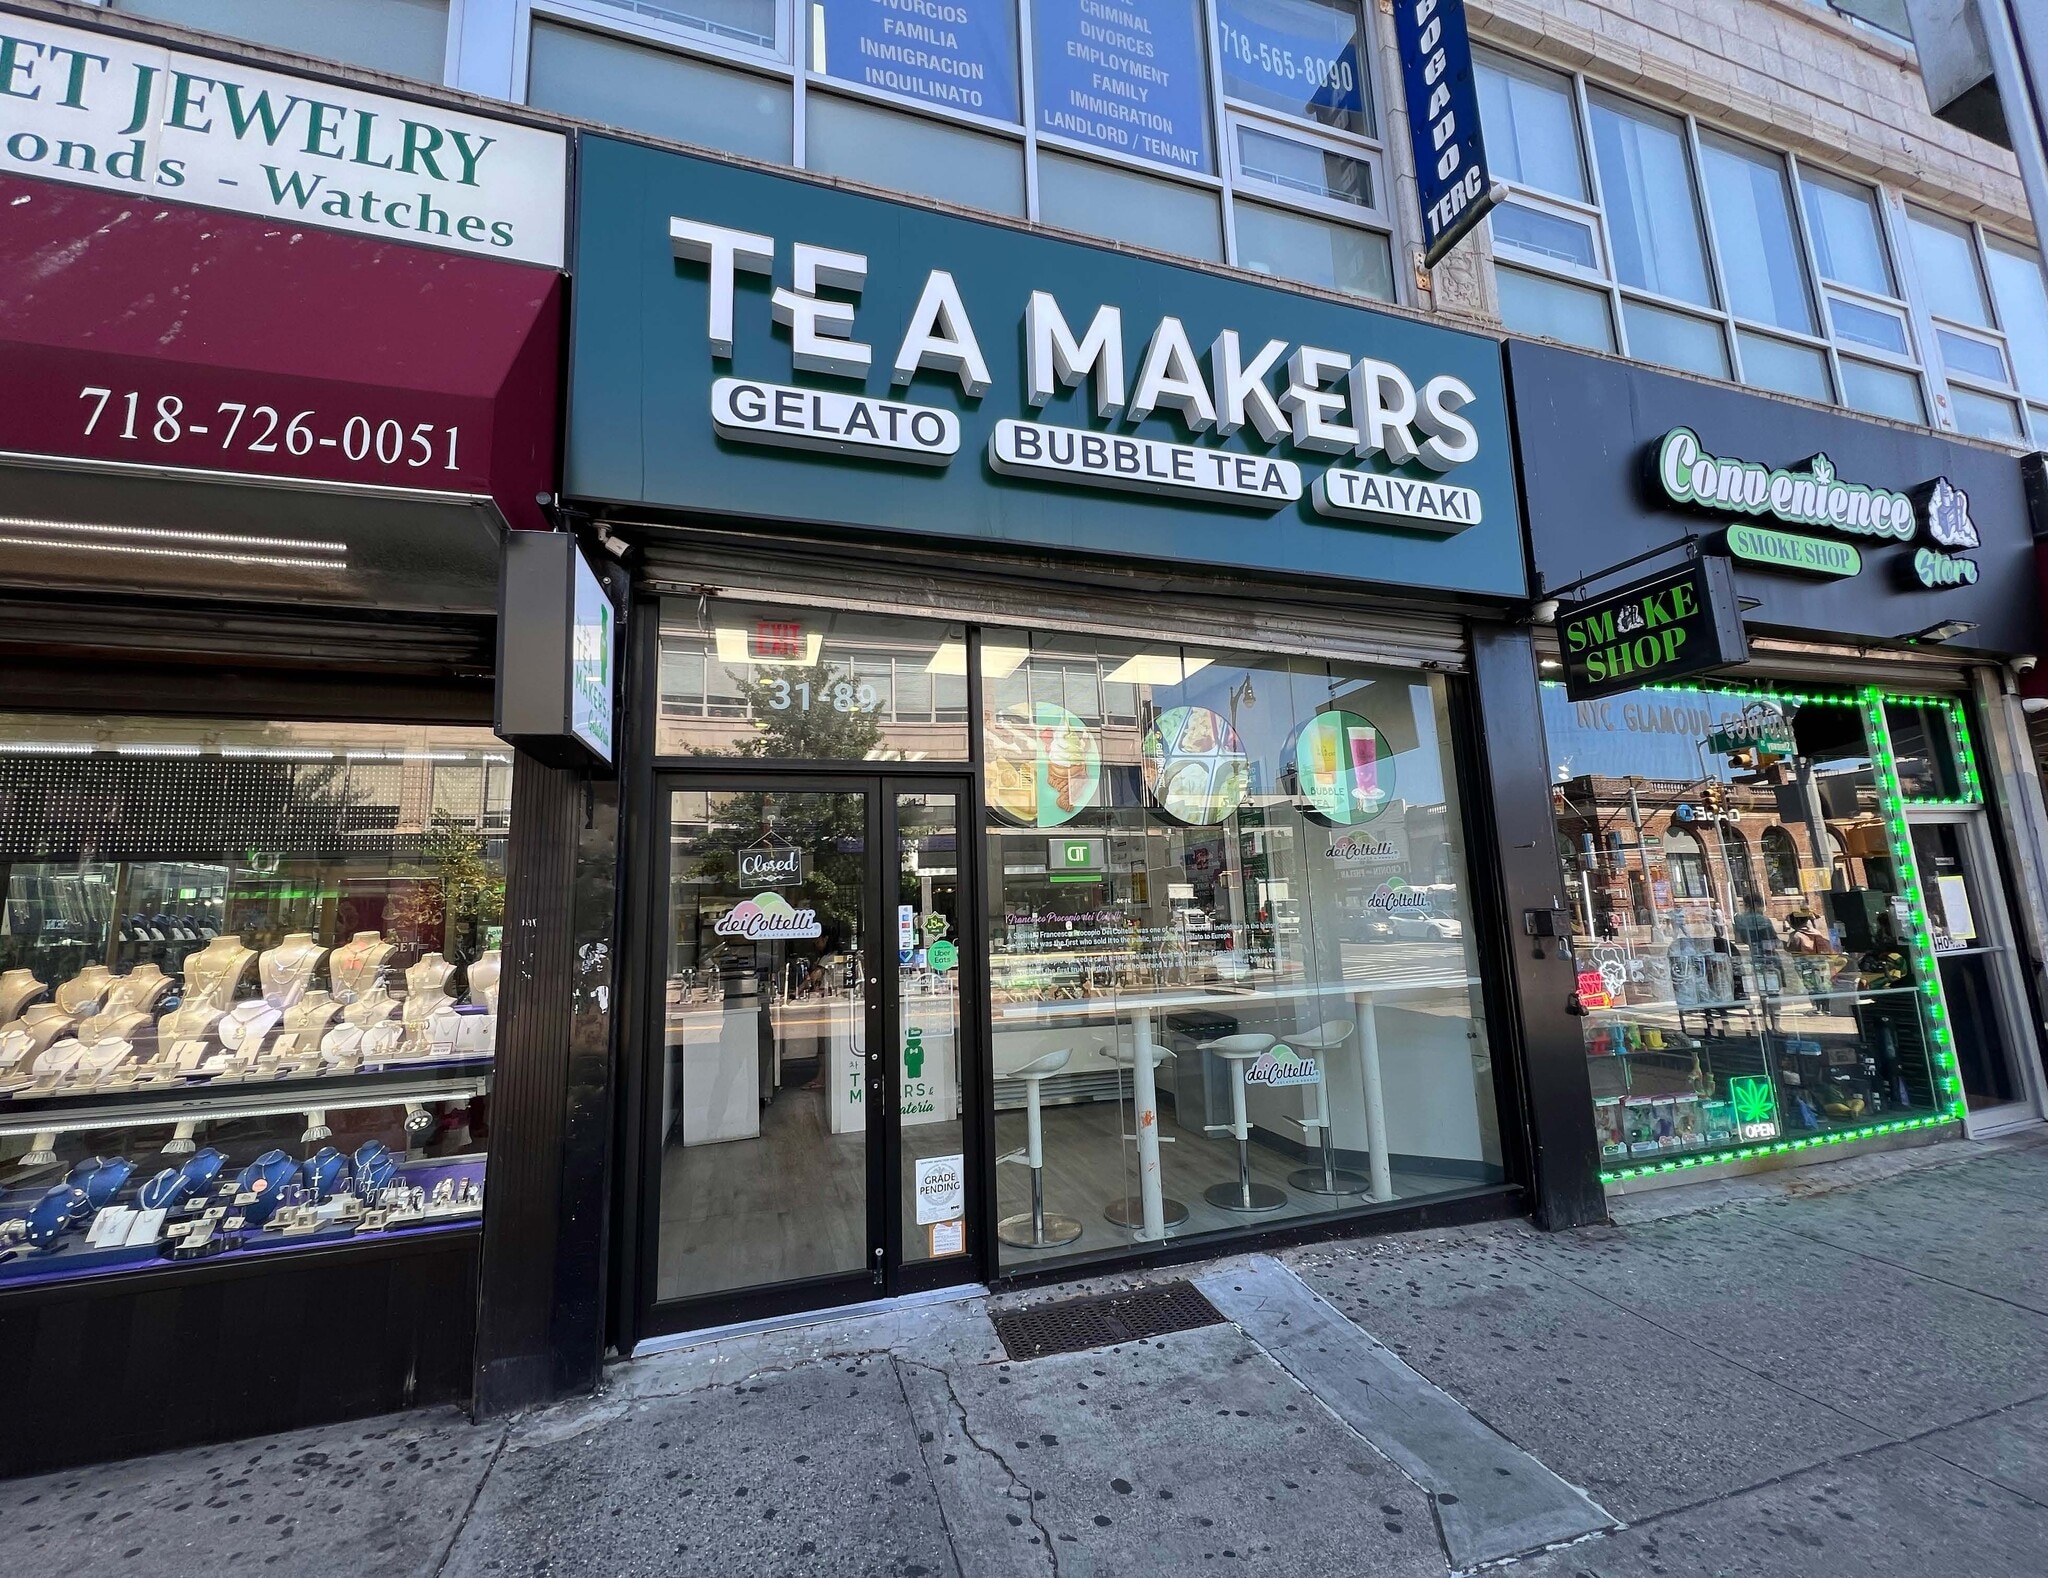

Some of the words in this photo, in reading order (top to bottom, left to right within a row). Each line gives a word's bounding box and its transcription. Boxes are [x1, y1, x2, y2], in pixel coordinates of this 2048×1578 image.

[870, 0, 968, 24] IVORCIOS
[1081, 0, 1152, 35] CRIMINAL
[883, 18, 958, 50] FAMILIA
[1081, 21, 1154, 58] DIVORCES
[860, 37, 984, 80] INMIGRACION
[1067, 41, 1170, 88] EMPLOYMENT
[1220, 21, 1354, 92] 718-565-8090
[865, 67, 983, 107] INQUILINATO
[1092, 73, 1149, 103] FAMILY
[118, 63, 498, 188] JEWELRY
[1070, 90, 1173, 135] IMMIGRATION
[1044, 109, 1128, 145] LANDLORD
[1142, 135, 1199, 167] TENANT
[6, 131, 186, 188] onds
[259, 164, 515, 249] Watches
[1427, 165, 1482, 236] TERC
[669, 216, 991, 398] TEA
[1025, 290, 1480, 472] MAKERS
[78, 386, 460, 472] 718-726-0051
[728, 384, 948, 448] GELATO
[1012, 427, 1194, 485] BUBBLE
[1209, 453, 1288, 497] TEA
[1339, 471, 1473, 522] TAIYAKI
[1663, 434, 1914, 533] Convenience
[1736, 531, 1804, 562] SMOKE
[1805, 544, 1850, 570] SHOP
[1566, 582, 1699, 653] SMKE
[1586, 627, 1687, 684] SHOP
[768, 678, 877, 713] 31-89
[1310, 787, 1345, 796] BUBBLE
[742, 851, 799, 876] Closed
[846, 954, 854, 986] PUSH
[1745, 1122, 1776, 1139] OPEN
[919, 1181, 961, 1196] PENDING
[924, 1172, 956, 1185] GRADE
